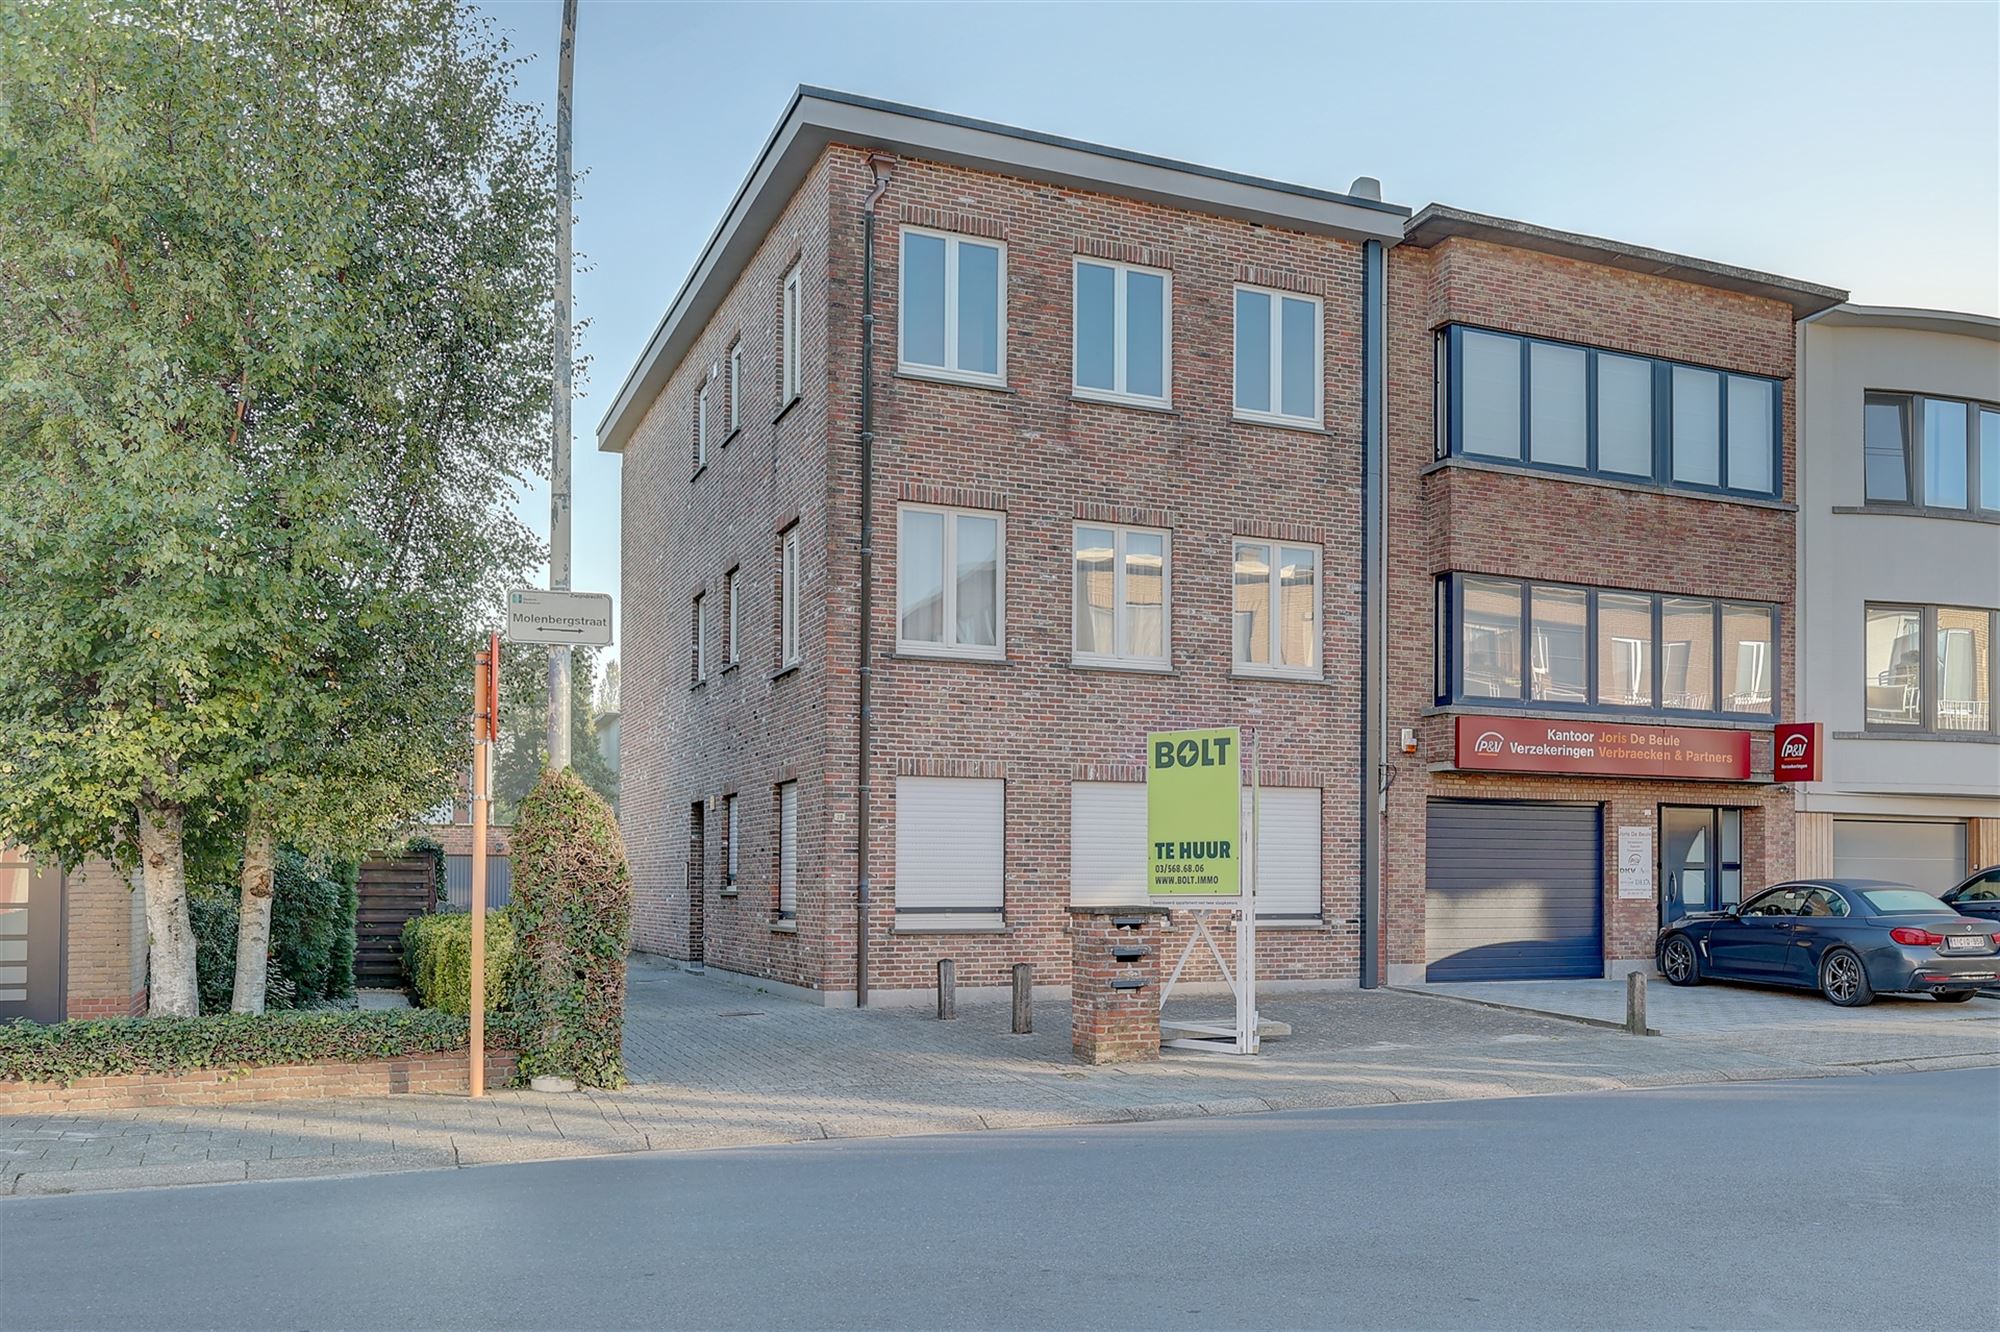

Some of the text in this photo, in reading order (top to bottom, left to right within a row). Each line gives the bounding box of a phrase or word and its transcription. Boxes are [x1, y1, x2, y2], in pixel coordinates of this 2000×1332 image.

[513, 613, 607, 627] Molenbergstraat
[1547, 728, 1680, 746] Kantoor Joris De Beule
[1155, 737, 1231, 769] BOLT
[1479, 740, 1503, 753] P&V
[1509, 742, 1733, 763] Verzekeringen Verbraecken & Partners
[1155, 841, 1231, 860] TE HUUR
[1155, 864, 1205, 873] 03/568.68.06
[1155, 875, 1219, 885] WWW.BOLT.IMMO
